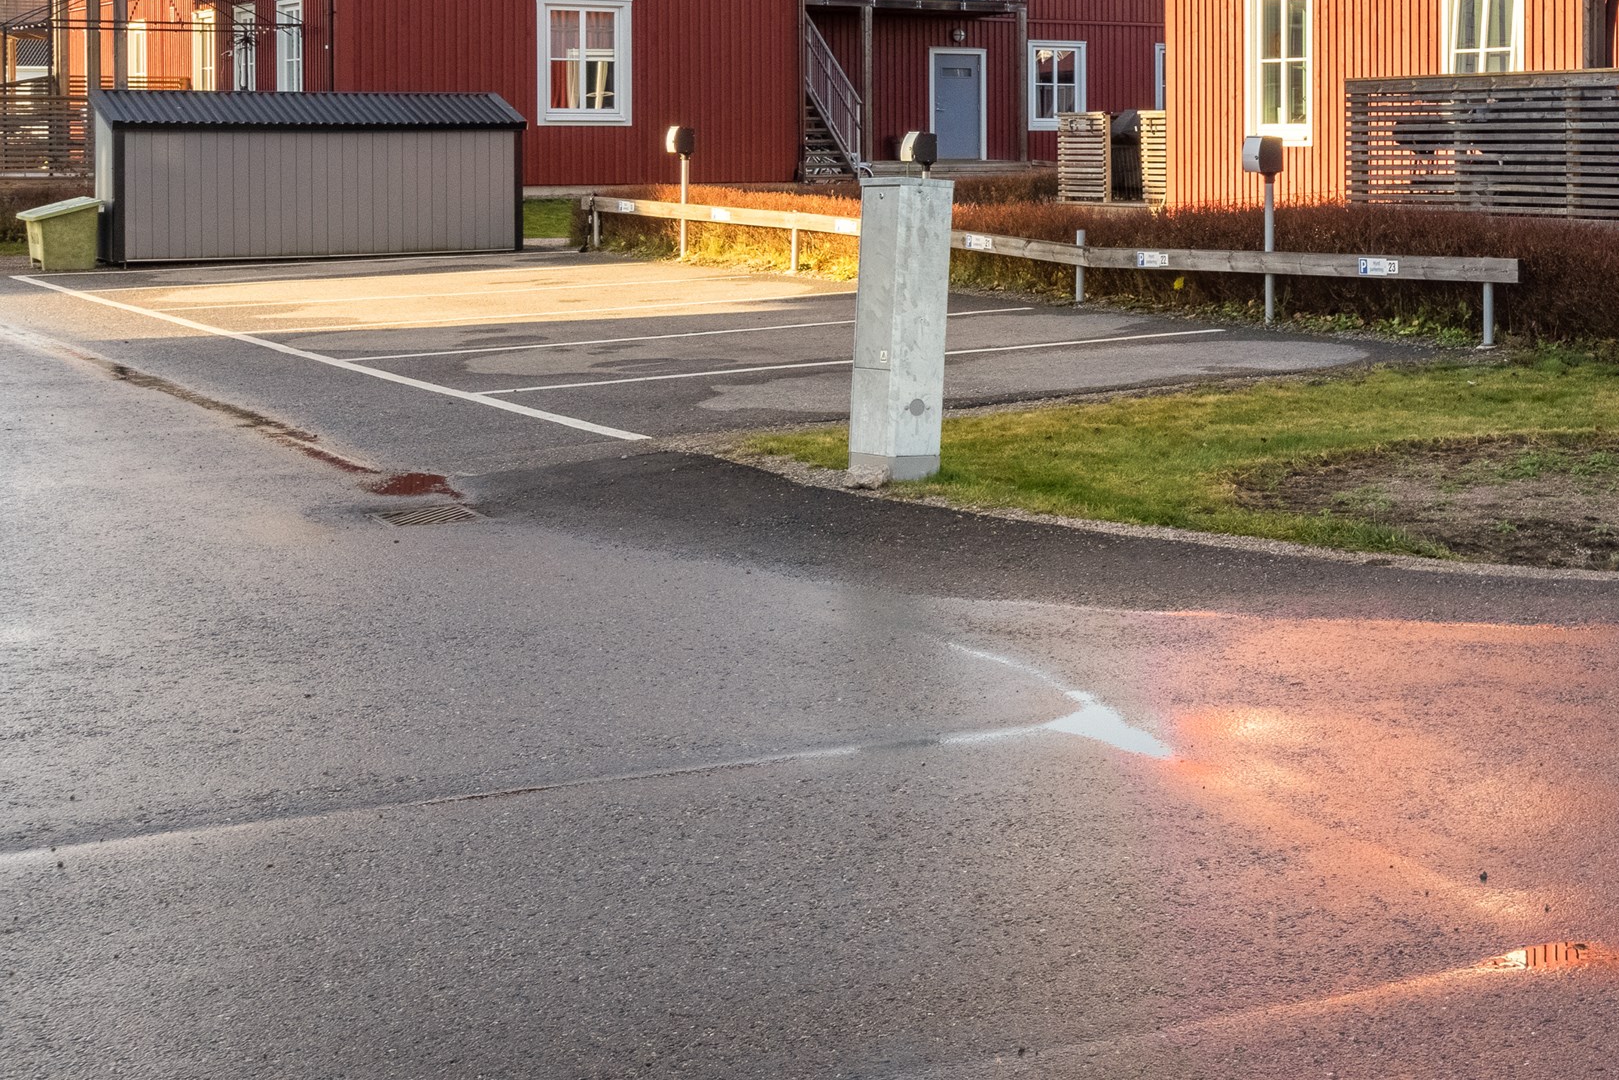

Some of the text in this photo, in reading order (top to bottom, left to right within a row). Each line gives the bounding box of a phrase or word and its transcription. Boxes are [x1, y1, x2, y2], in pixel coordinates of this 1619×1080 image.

[1160, 255, 1167, 265] 22
[1360, 260, 1367, 273] P
[1388, 262, 1396, 272] 23
